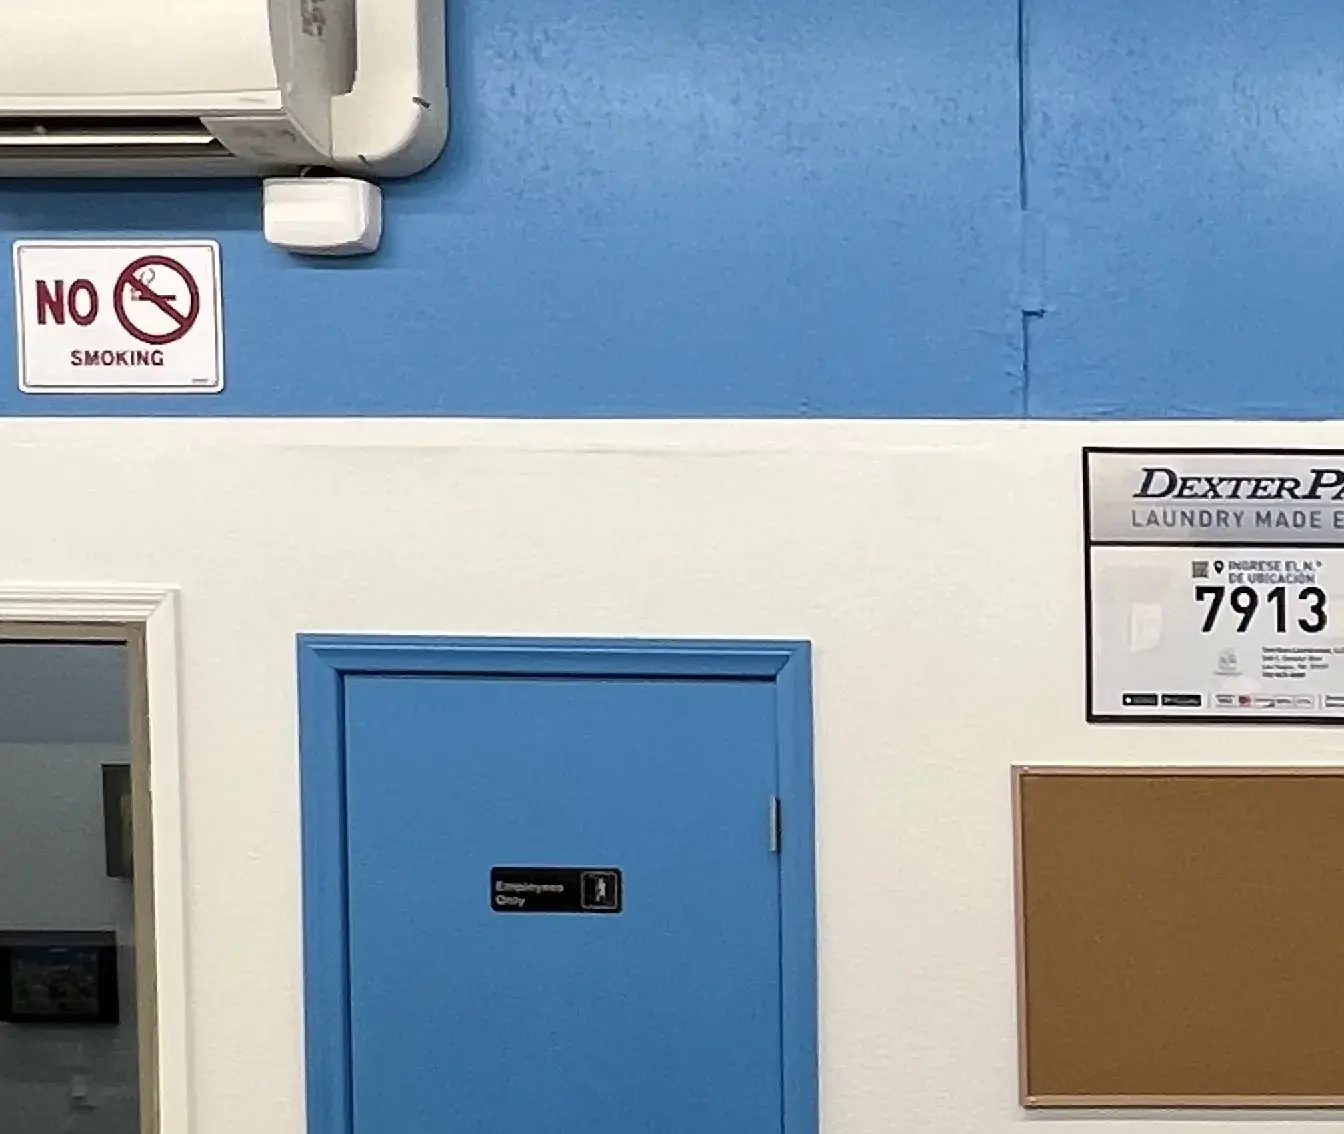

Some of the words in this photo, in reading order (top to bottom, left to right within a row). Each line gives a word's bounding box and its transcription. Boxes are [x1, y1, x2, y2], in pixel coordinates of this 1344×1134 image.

[35, 278, 99, 326] NO
[70, 350, 164, 367] SMOKING
[1131, 510, 1244, 528] LAUNDRY
[1255, 510, 1322, 529] MADE
[1195, 586, 1327, 633] 7913
